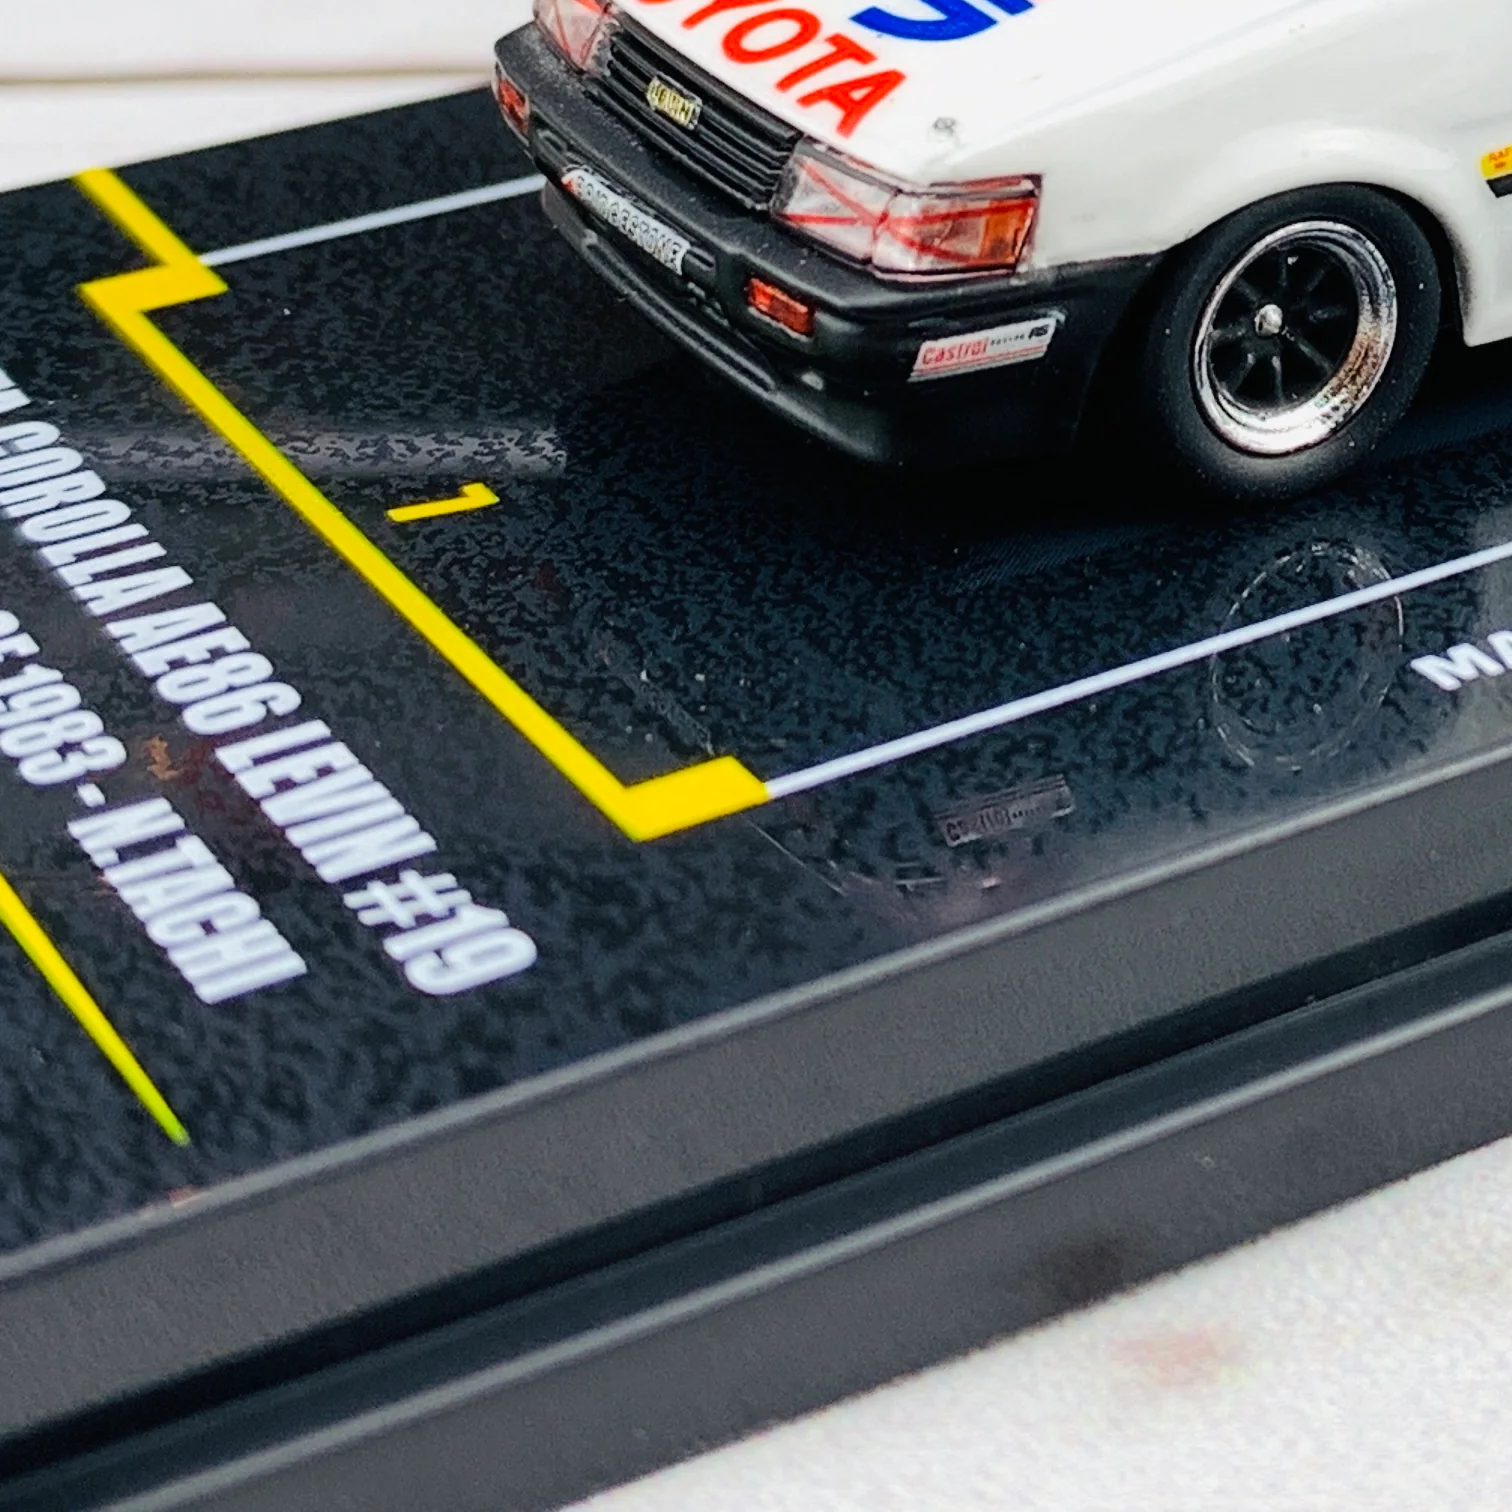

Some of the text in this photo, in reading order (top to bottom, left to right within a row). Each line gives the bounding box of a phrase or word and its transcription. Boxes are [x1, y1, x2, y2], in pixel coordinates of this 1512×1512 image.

[922, 337, 990, 366] Castrol
[0, 420, 537, 995] COROLLA AE86 LEVIN #19
[0, 663, 127, 785] 1983
